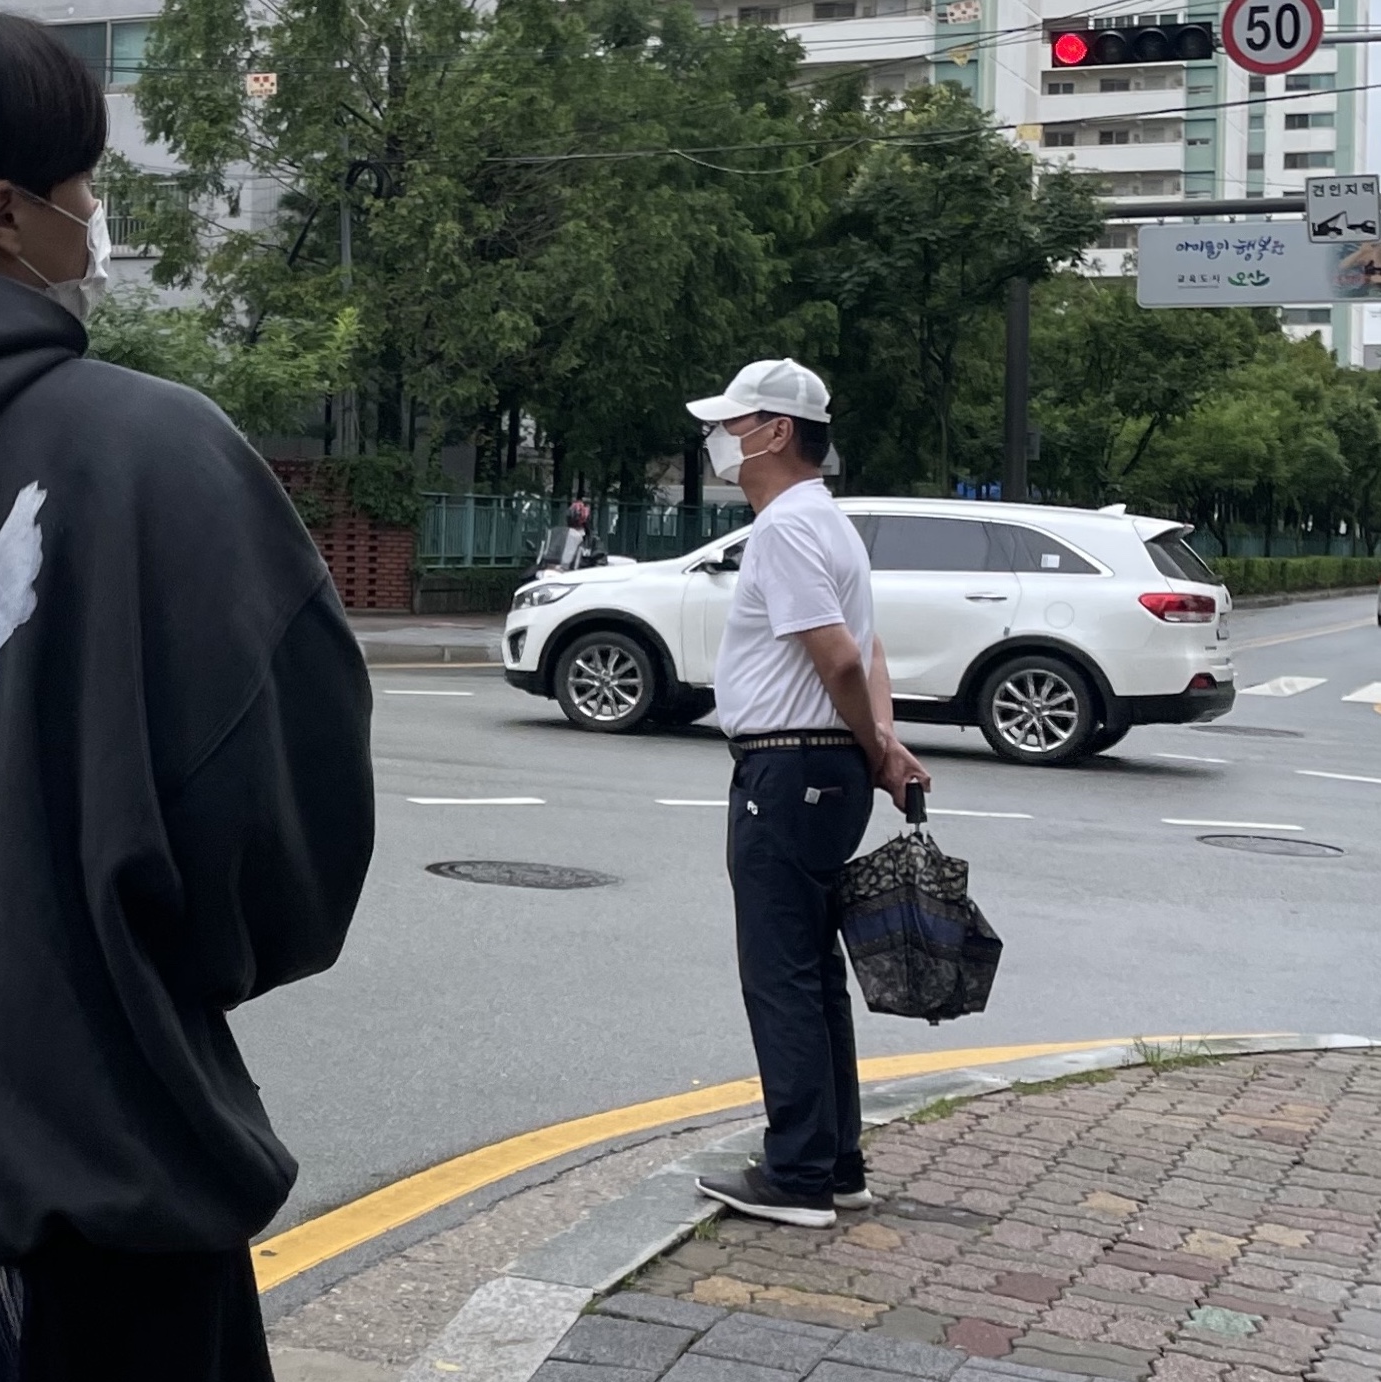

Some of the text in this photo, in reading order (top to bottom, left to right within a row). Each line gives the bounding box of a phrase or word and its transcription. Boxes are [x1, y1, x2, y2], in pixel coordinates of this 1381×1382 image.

[1246, 3, 1300, 51] 50
[1312, 182, 1375, 198] 견인지역
[1176, 236, 1285, 261] 아이들이 행복한
[1228, 270, 1270, 287] 오산
